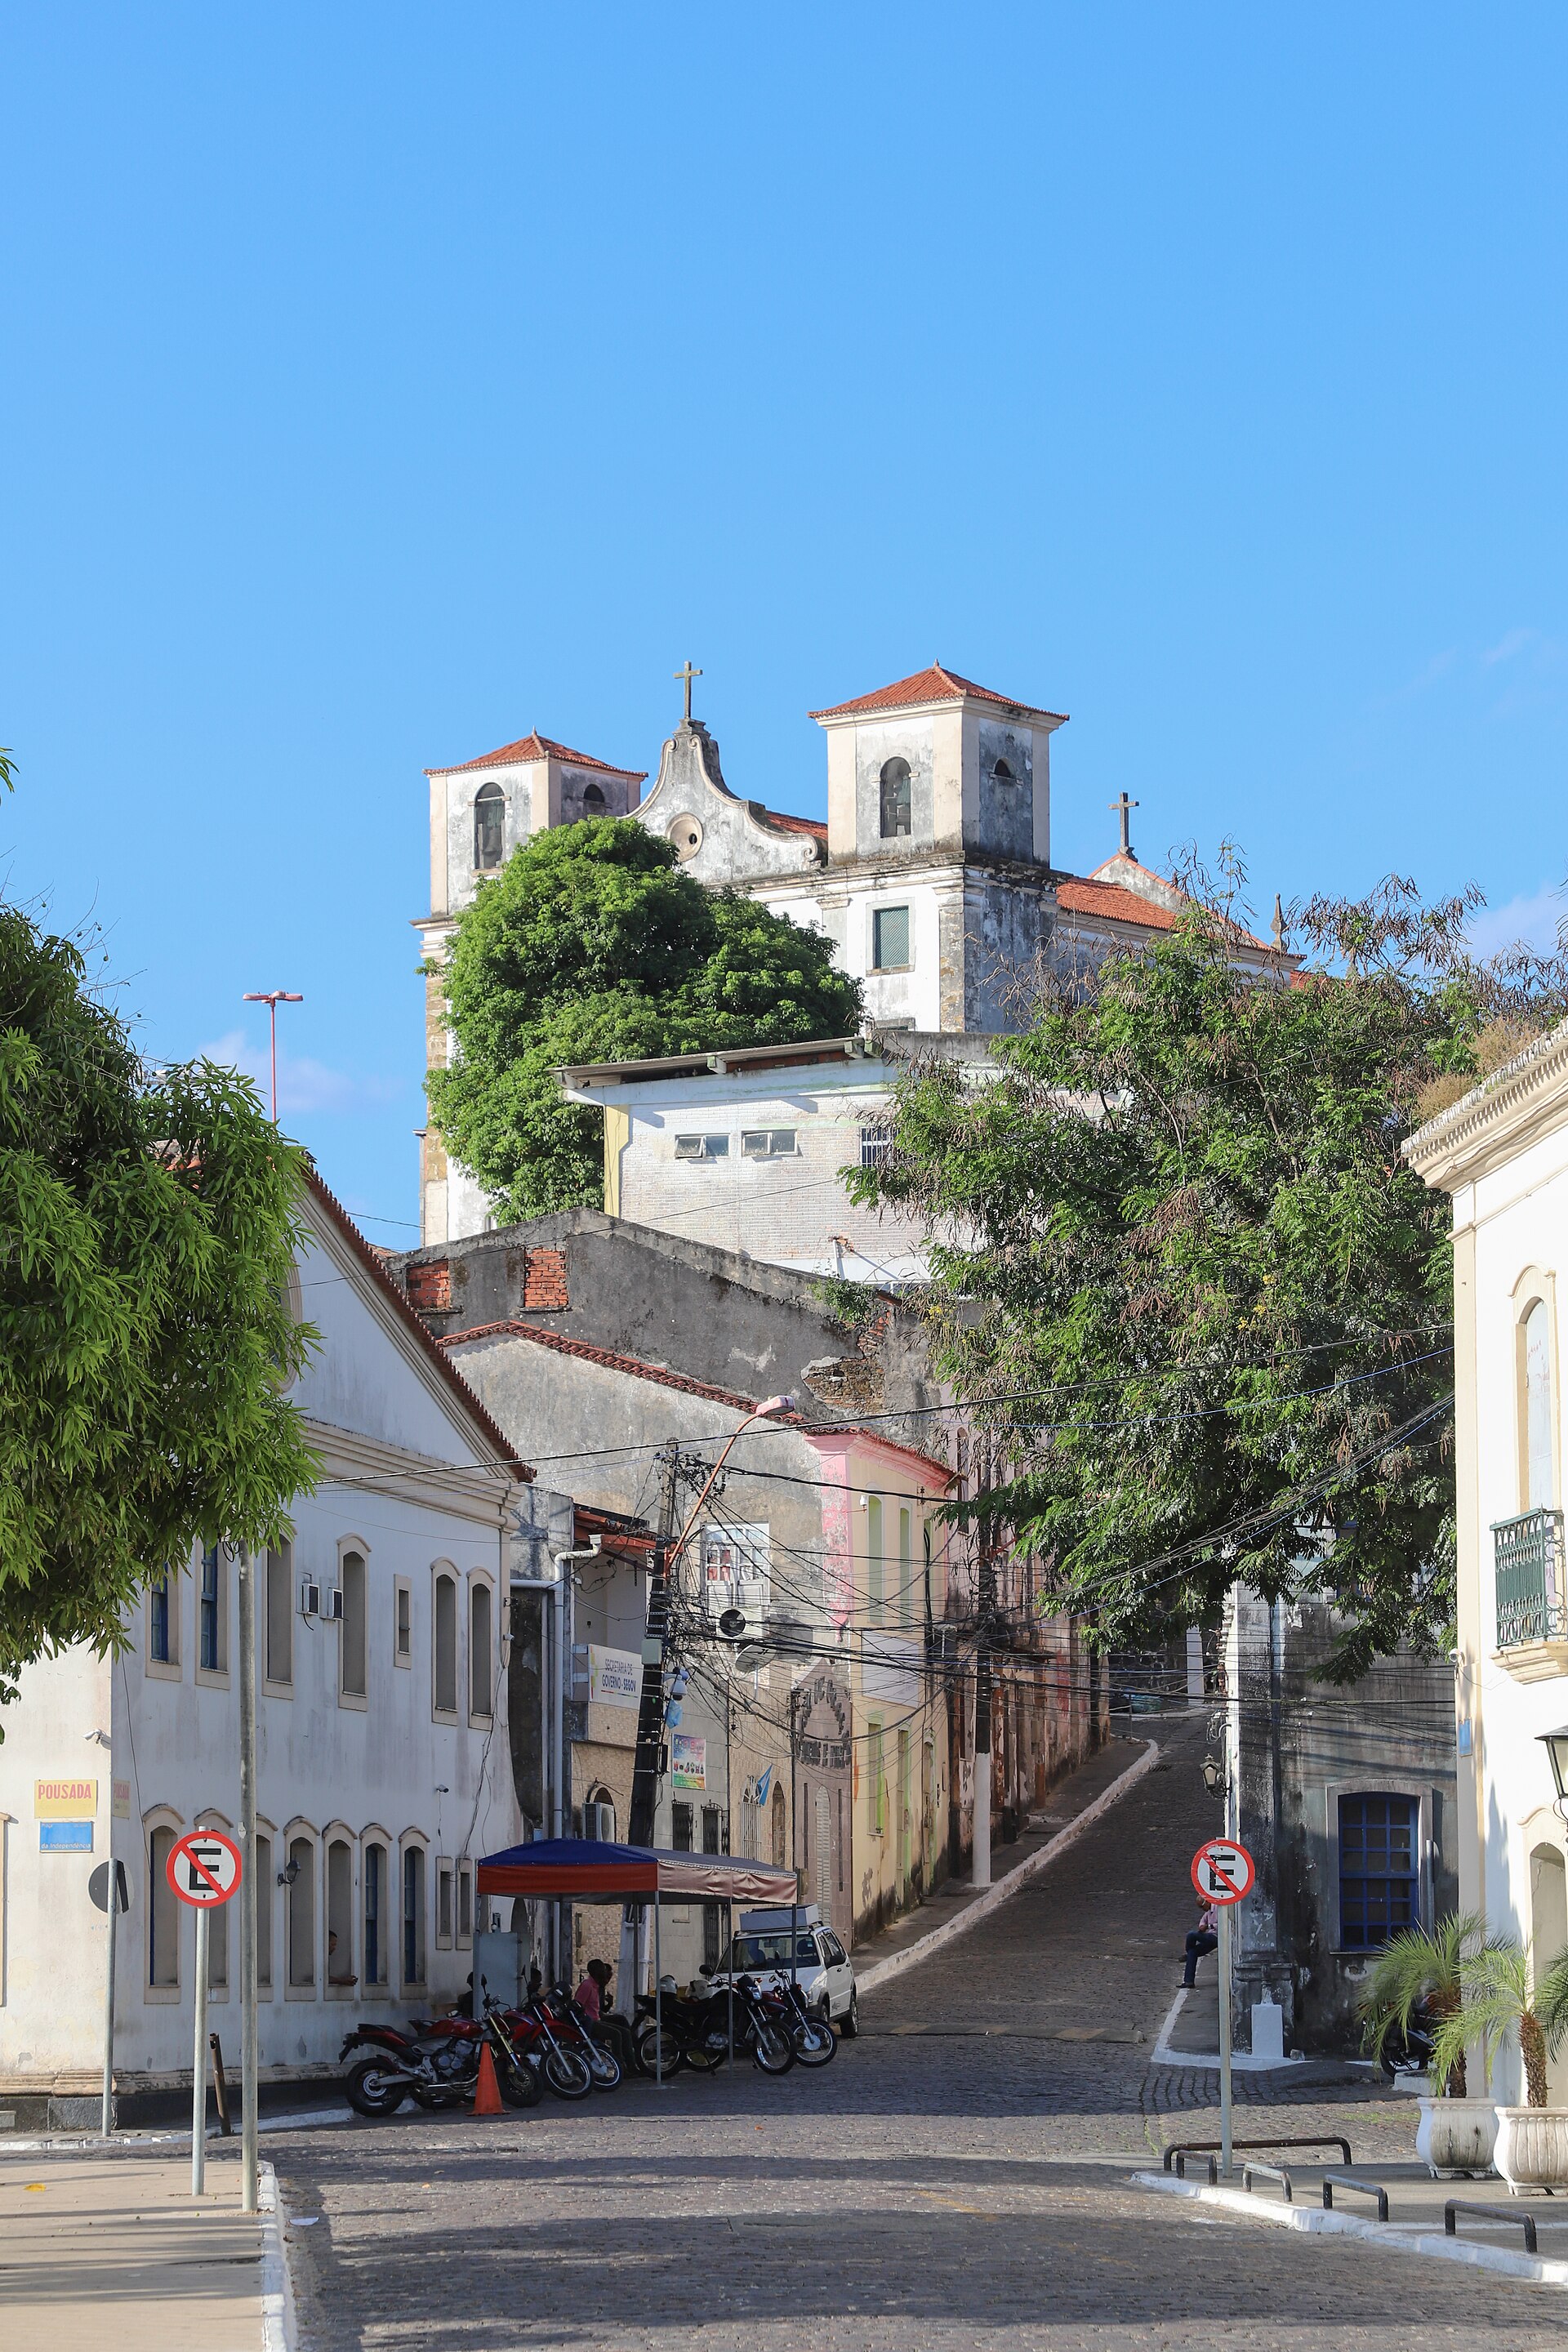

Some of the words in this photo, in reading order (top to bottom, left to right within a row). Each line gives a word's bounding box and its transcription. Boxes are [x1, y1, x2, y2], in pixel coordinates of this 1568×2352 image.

[605, 1659, 626, 1674] SECRETARIA
[627, 1663, 633, 1676] DE
[602, 1674, 621, 1689] GOVERNO
[623, 1678, 637, 1692] SEGOV
[38, 1784, 91, 1799] POUSADA
[114, 1783, 129, 1800] POUSADA
[189, 1848, 221, 1890] E
[1209, 1855, 1236, 1891] E
